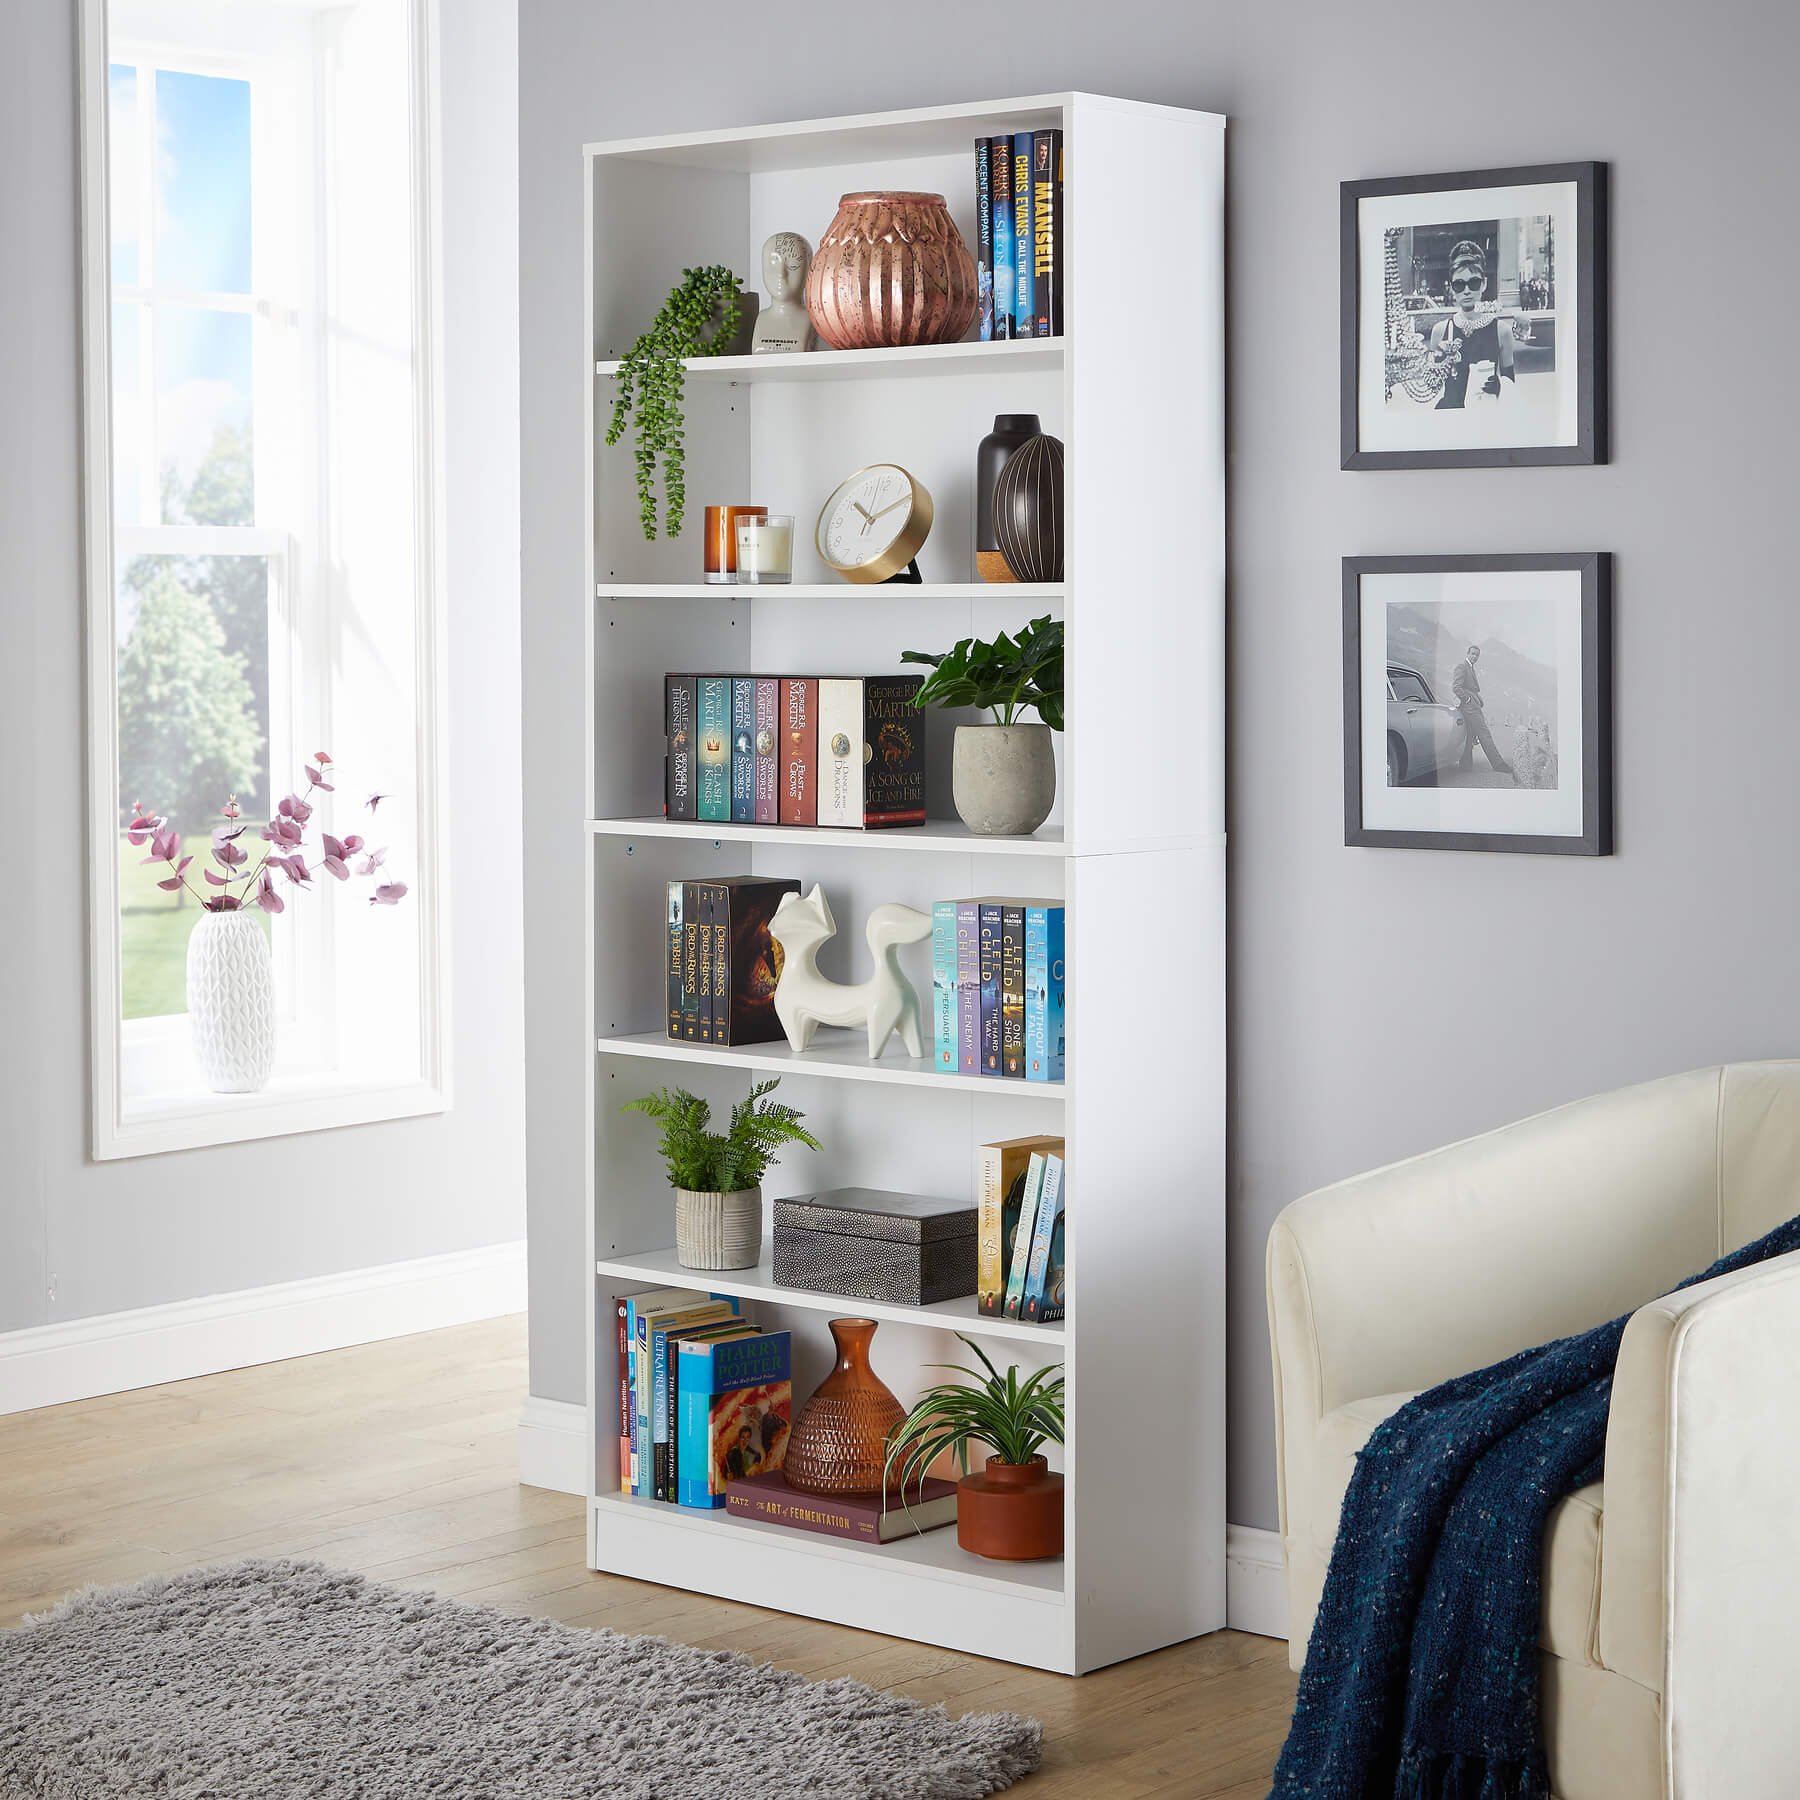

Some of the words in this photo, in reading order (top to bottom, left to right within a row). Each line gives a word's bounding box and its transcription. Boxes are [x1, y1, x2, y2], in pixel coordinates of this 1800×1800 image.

[979, 145, 989, 192] VINCENT
[999, 145, 1010, 200] ROBERT
[1015, 155, 1029, 193] CHRIS
[980, 194, 990, 246] KOMPANY
[1015, 196, 1030, 237] EVANS
[1034, 181, 1053, 278] MANSELL
[1018, 239, 1027, 258] CALL
[1018, 260, 1027, 274] THE
[1018, 276, 1028, 307] MIDLIFE
[681, 689, 690, 722] GAME
[735, 680, 745, 729] MARTIN
[743, 681, 752, 713] GEORGE
[758, 682, 767, 731] MARTIN
[766, 682, 774, 716] GEORGE
[789, 681, 800, 730] MARTIN
[798, 681, 807, 714] GEORGE
[868, 684, 903, 699] GEORGE
[672, 687, 680, 733] THRONES
[705, 682, 716, 738] MARTIN
[867, 699, 920, 719] MARTIN
[675, 753, 684, 797] MARTIN
[704, 769, 714, 804] KINGS
[713, 763, 723, 805] CLASH
[737, 756, 746, 799] SWORDS
[745, 763, 753, 792] STORM
[760, 757, 768, 800] SWORDS
[767, 763, 776, 792] STORM
[789, 761, 799, 798] CROWS
[797, 764, 806, 791] FEAST
[833, 760, 843, 809] DRAGONS
[868, 771, 876, 788] A
[878, 771, 908, 788] SONG
[867, 788, 883, 804] ICE
[885, 790, 903, 803] AND
[703, 891, 708, 901] 2
[685, 923, 697, 951] LORD
[700, 925, 710, 953] LORD
[714, 925, 726, 954] LORD
[670, 931, 681, 978] HOBBIT
[958, 929, 969, 981] CHILD
[981, 928, 992, 981] CHILD
[992, 939, 1001, 971] LEE
[1003, 935, 1013, 987] CHILD
[1013, 946, 1023, 977] LEE
[685, 959, 697, 994] RINGS
[700, 961, 710, 996] RINGS
[714, 962, 726, 997] RINGS
[964, 991, 972, 1011] THE
[964, 1014, 973, 1050] ENEMY
[1004, 1019, 1013, 1050] SHOT
[1012, 1023, 1021, 1047] ONE
[1027, 1014, 1036, 1041] FAIL
[1035, 1000, 1044, 1057] WITHOUT
[718, 1356, 782, 1379] POTTER
[719, 1341, 778, 1363] HARRY
[669, 1416, 675, 1427] OF
[730, 1496, 749, 1507] KATZ
[766, 1502, 781, 1515] ART
[790, 1506, 850, 1529] FERMENTATION
